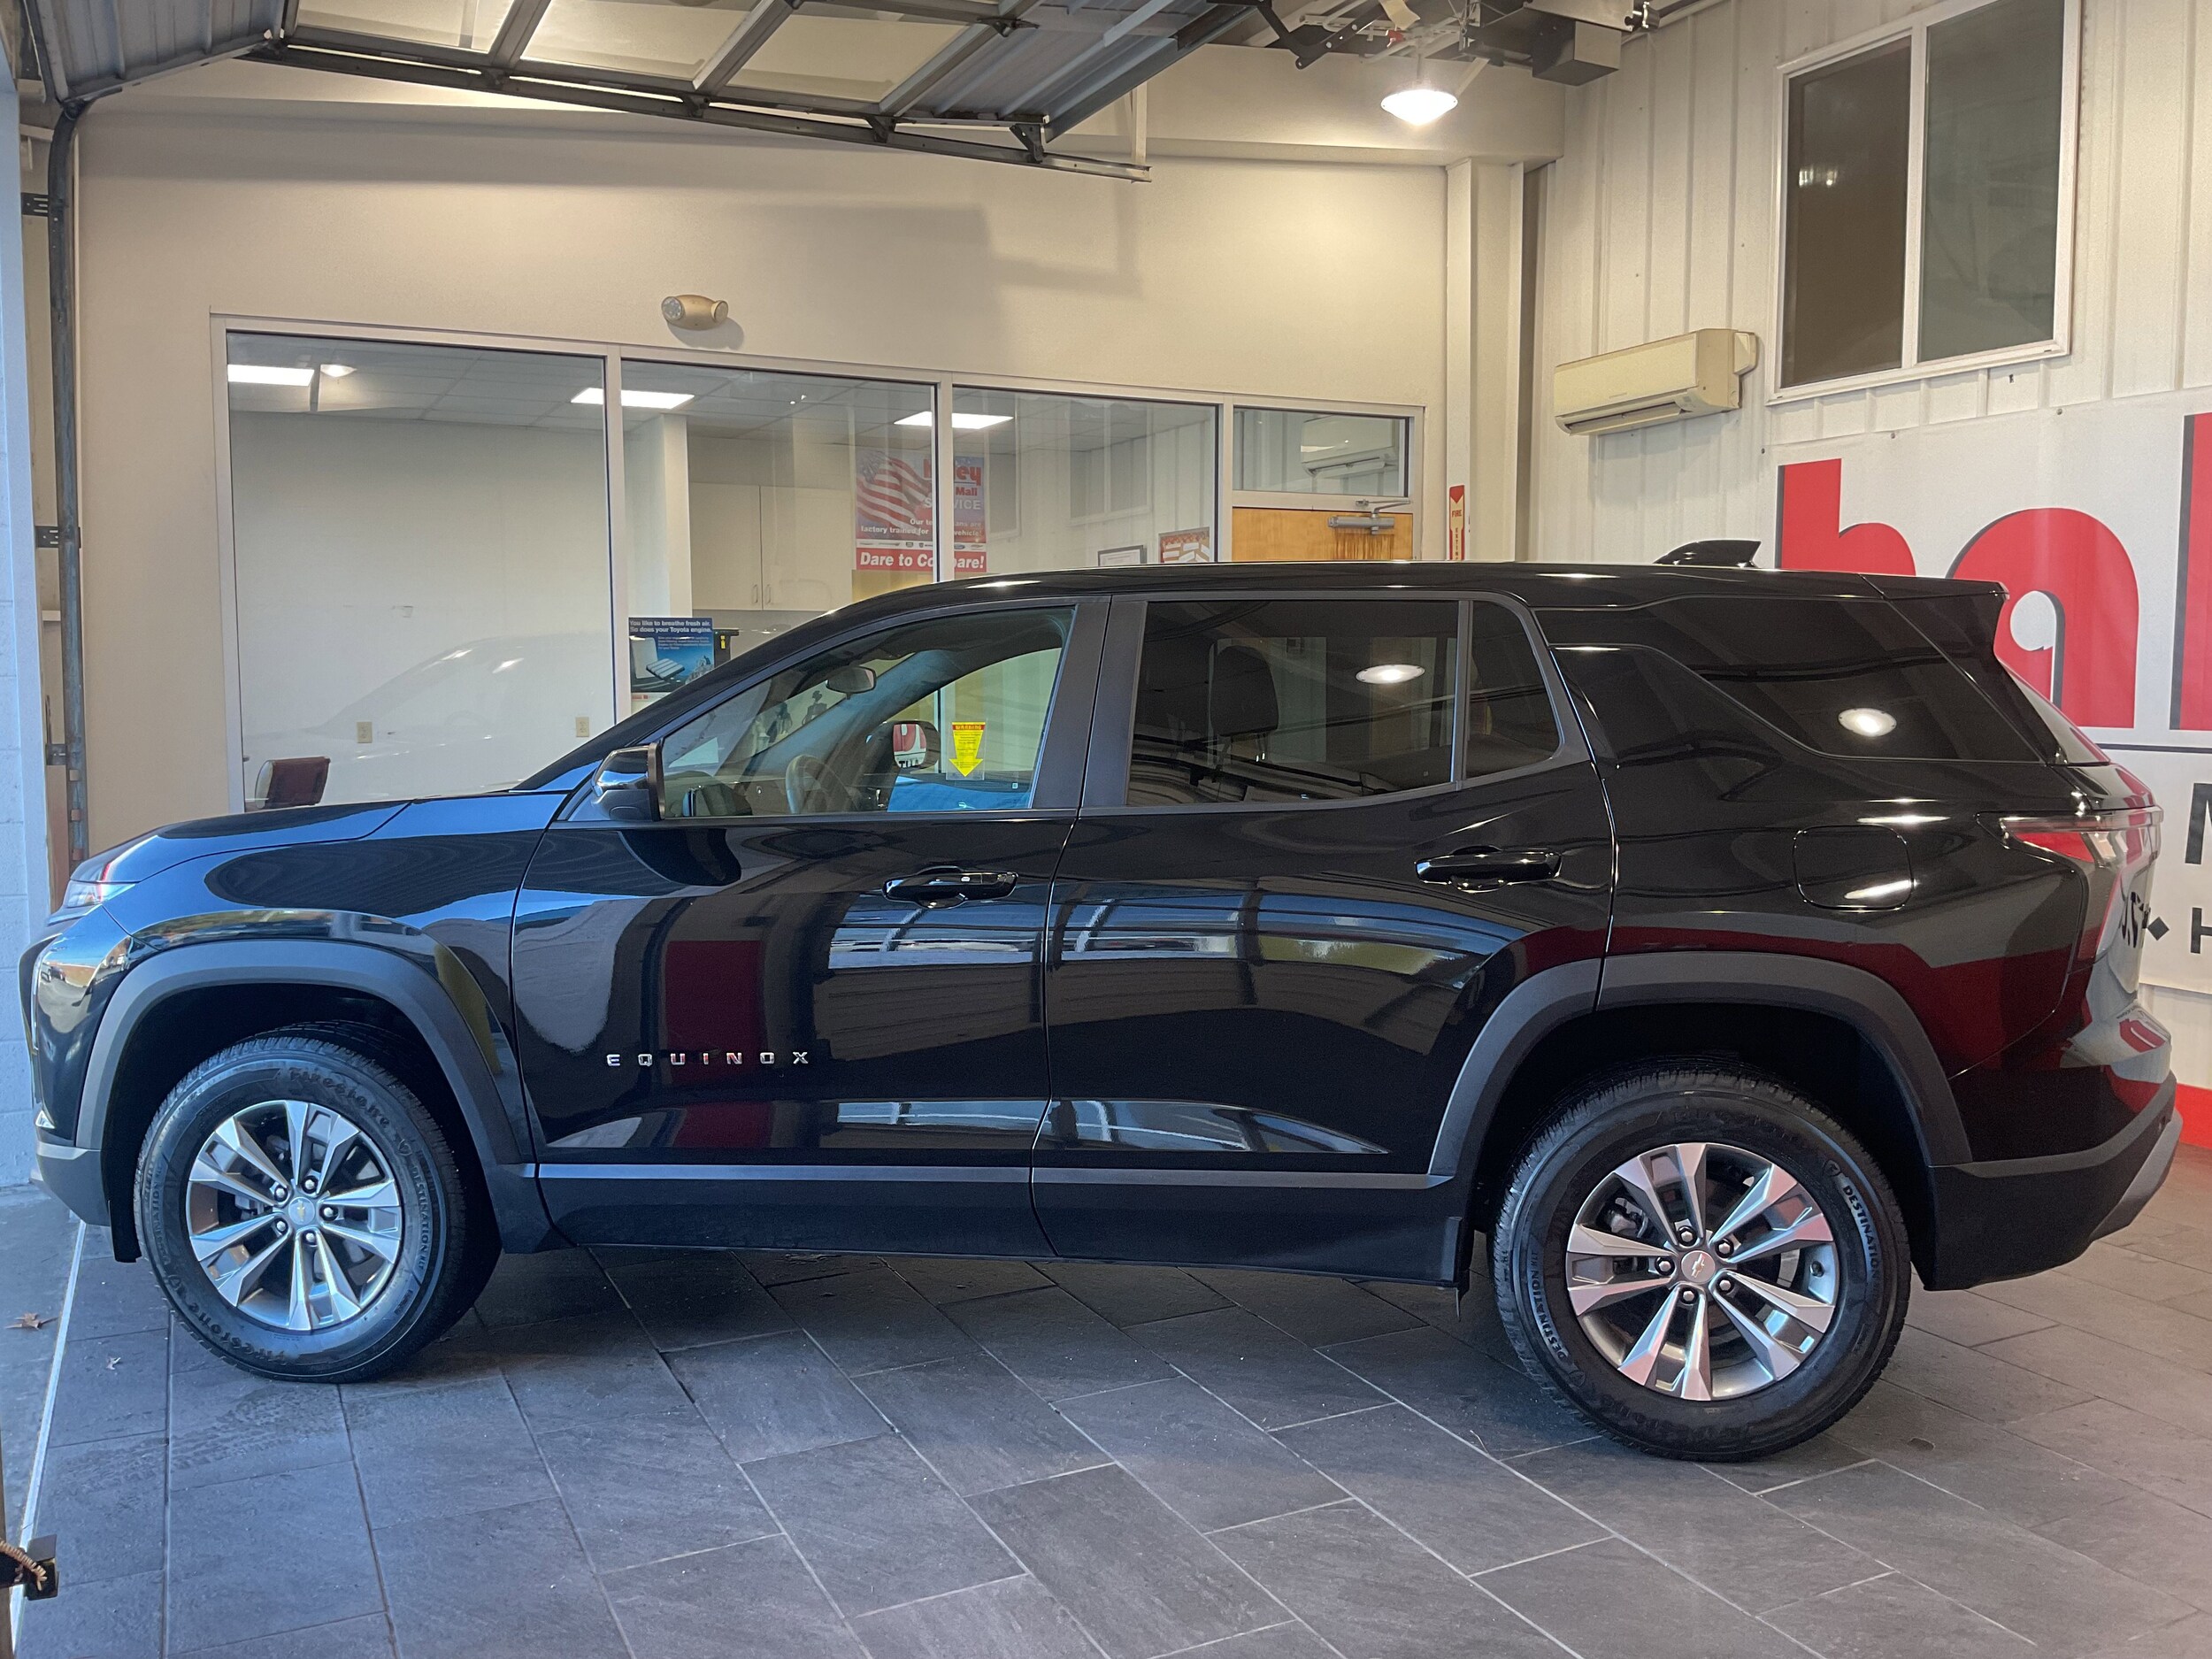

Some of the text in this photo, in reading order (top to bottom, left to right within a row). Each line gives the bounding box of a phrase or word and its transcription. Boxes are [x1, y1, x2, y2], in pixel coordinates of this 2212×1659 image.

[1451, 509, 1463, 518] FIRE
[861, 525, 887, 534] factory
[860, 551, 895, 566] Dare
[898, 553, 913, 567] to
[606, 1051, 809, 1067] EQUINOX
[288, 1066, 390, 1127] Firestone
[1843, 1185, 1879, 1279] DESTINATION
[1531, 1270, 1567, 1359] DESTINATION
